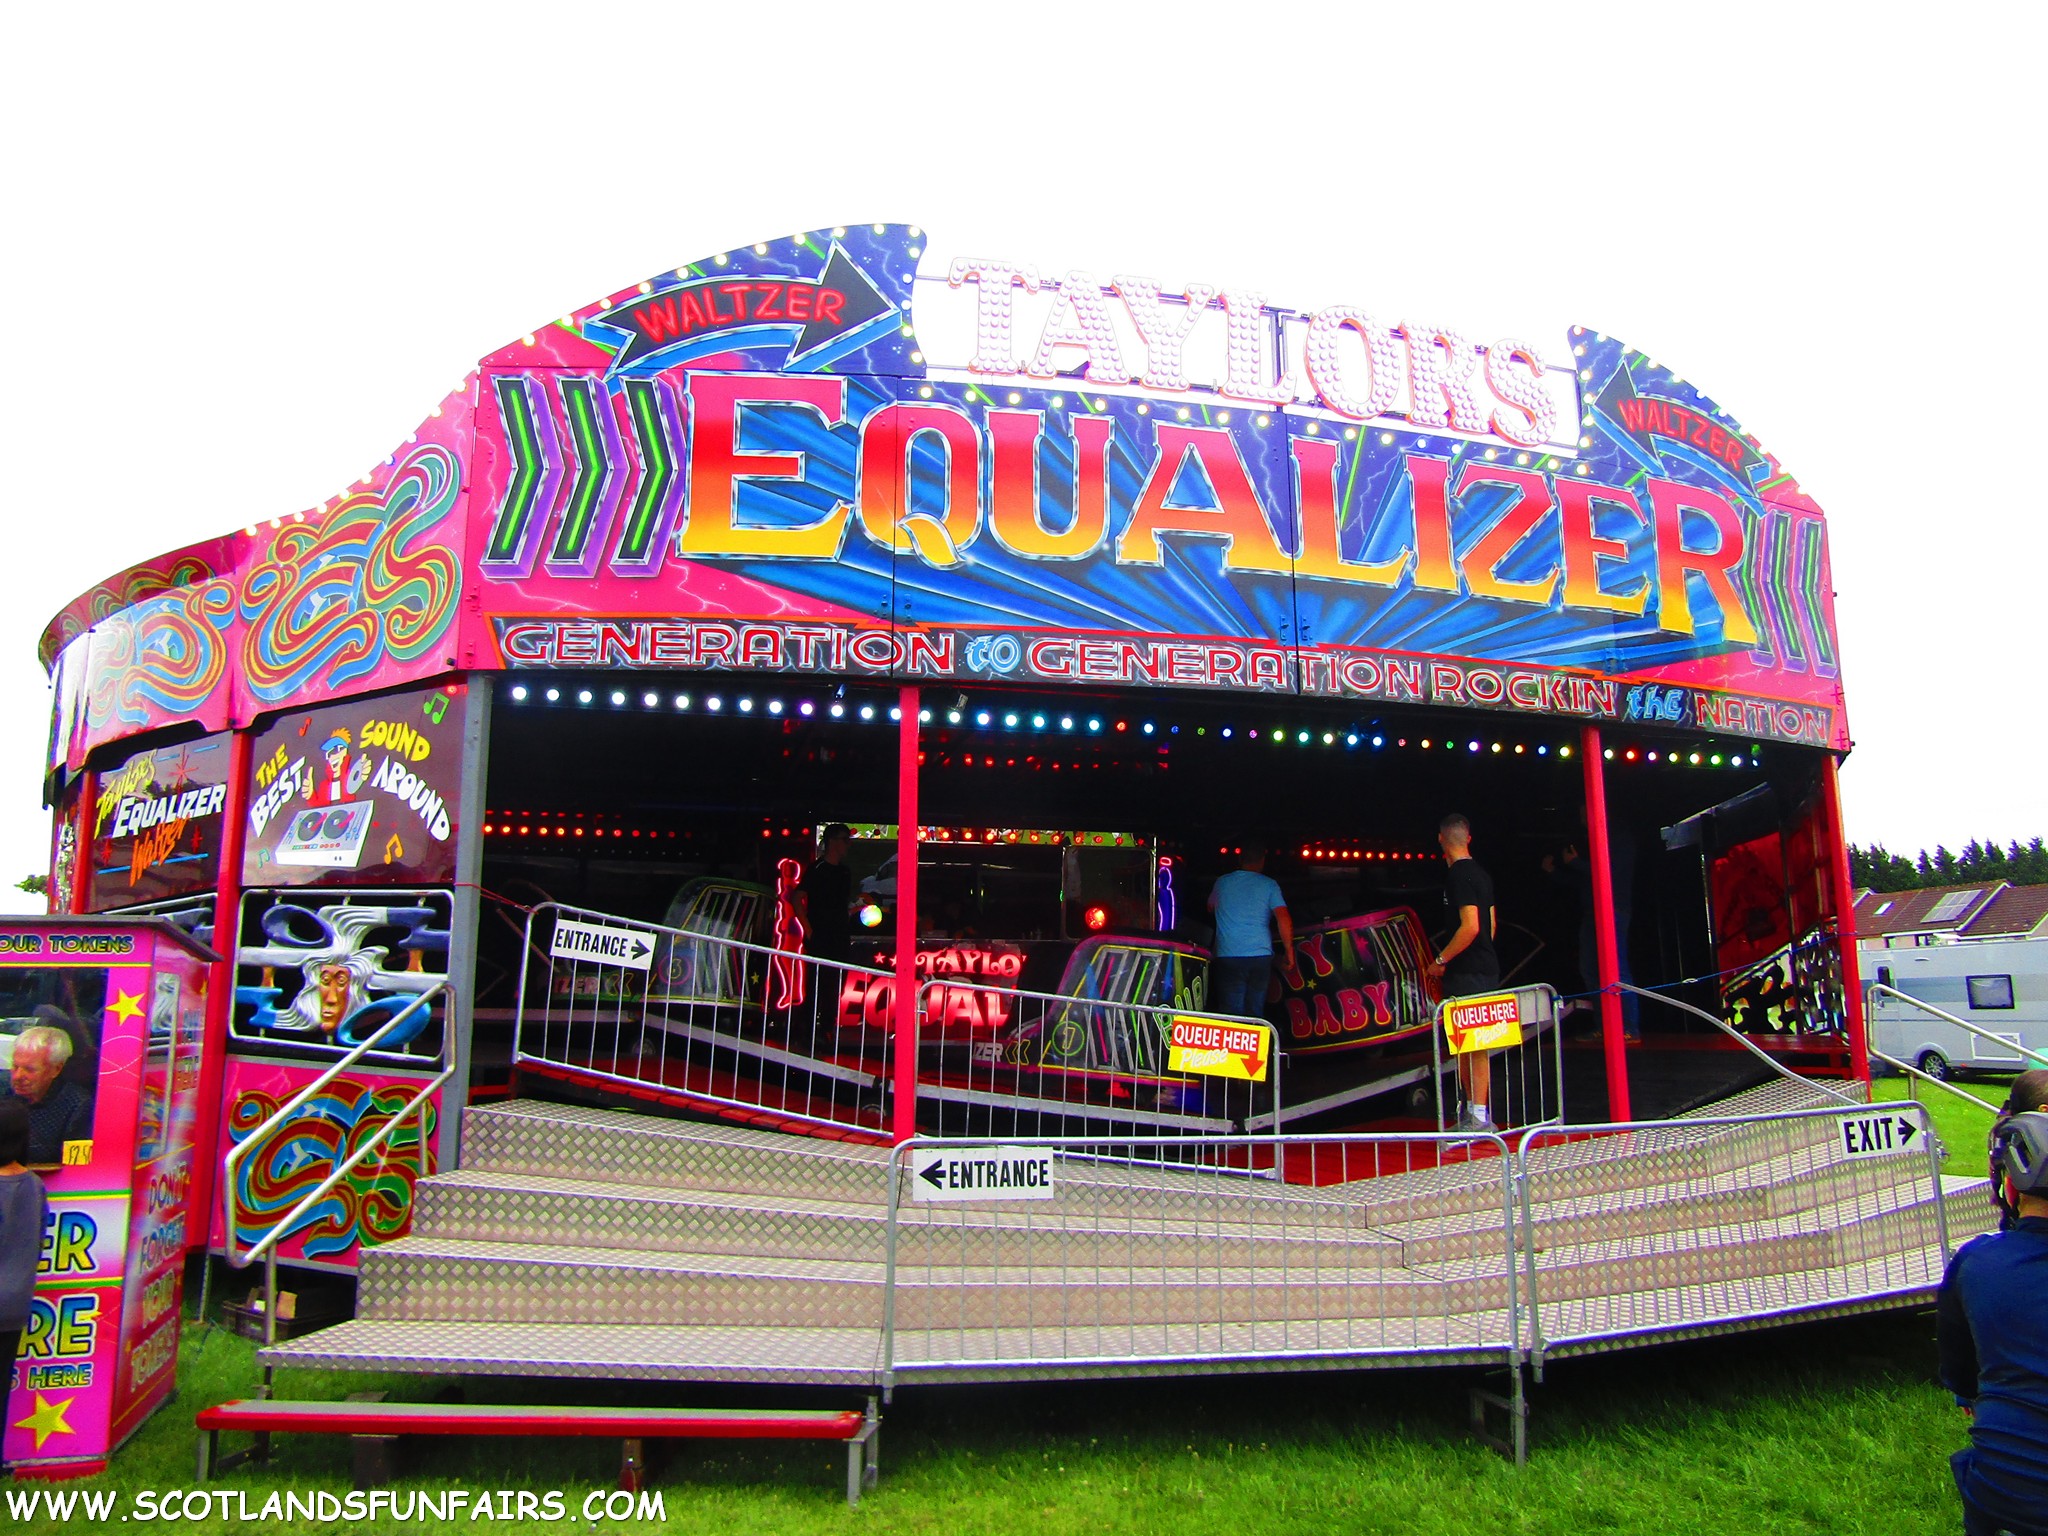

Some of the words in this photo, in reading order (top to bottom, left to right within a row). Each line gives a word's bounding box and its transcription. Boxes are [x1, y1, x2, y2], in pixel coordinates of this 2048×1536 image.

[634, 283, 845, 342] WALTZER
[947, 256, 1557, 447] TAYLORS
[1617, 399, 1744, 471] WALTZER
[677, 371, 1763, 643] EQUALIZER
[500, 620, 955, 676] GENERATION
[964, 633, 1022, 674] to
[1027, 636, 1424, 697] GENERATION
[1430, 666, 1620, 717] ROCKIN
[1625, 684, 1684, 720] the
[1696, 693, 1830, 743] NATION
[358, 719, 431, 762] SOUND
[256, 743, 289, 788] THE
[112, 784, 228, 839] EQUALIZER
[250, 755, 307, 838] BEST
[370, 754, 451, 841] AROUND
[48, 934, 135, 954] TOKENS
[554, 928, 629, 957] ENTRANCE
[1287, 980, 1393, 1038] BABY
[1453, 1006, 1488, 1029] QUEUE
[1490, 1002, 1516, 1021] HERE
[1174, 1024, 1220, 1048] QUEUE
[1223, 1030, 1258, 1052] HERE
[1474, 1020, 1509, 1048] Please
[1180, 1047, 1229, 1069] Please
[1843, 1117, 1893, 1153] EXIT
[949, 1159, 1050, 1189] ENTRANCE
[27, 1362, 94, 1391] HERE
